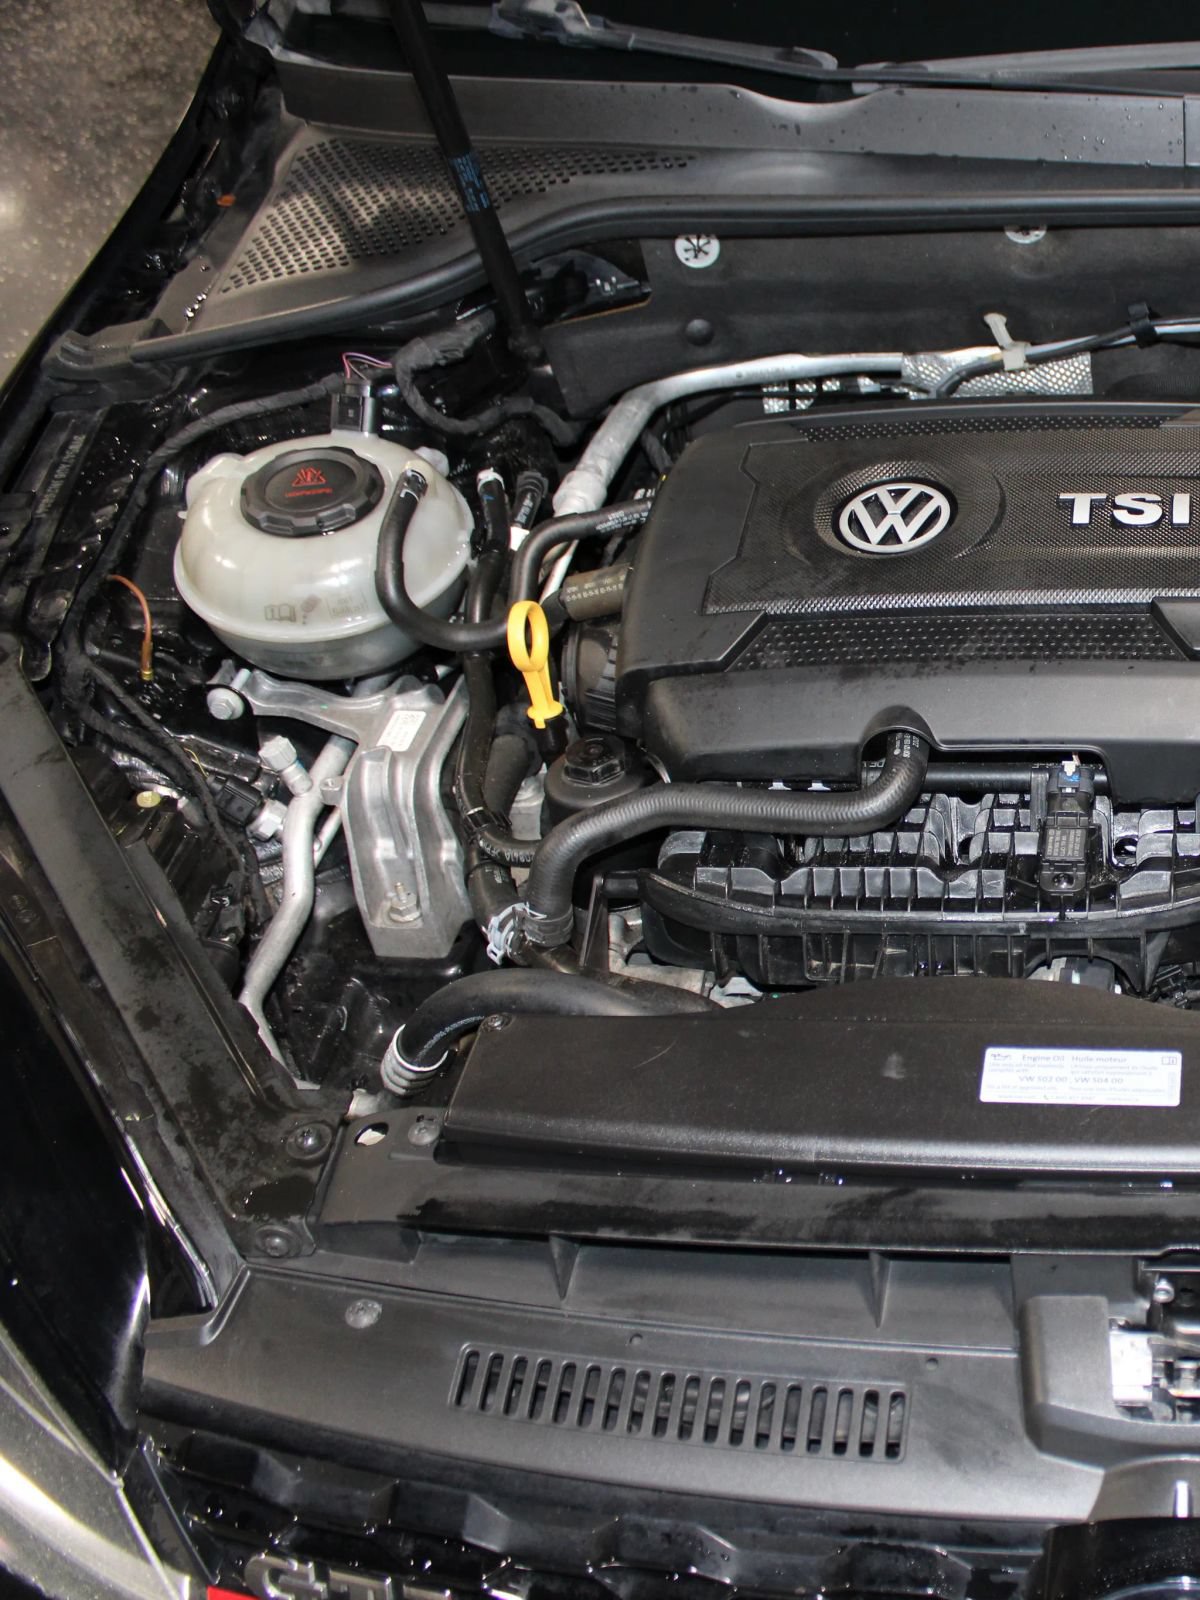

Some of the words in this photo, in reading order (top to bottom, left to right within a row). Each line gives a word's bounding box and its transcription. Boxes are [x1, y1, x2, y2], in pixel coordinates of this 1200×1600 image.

[1058, 492, 1190, 526] TSI
[1022, 1054, 1051, 1063] Engine
[1052, 1054, 1065, 1062] Oil
[1071, 1055, 1094, 1063] Huile
[1095, 1055, 1127, 1063] moteur
